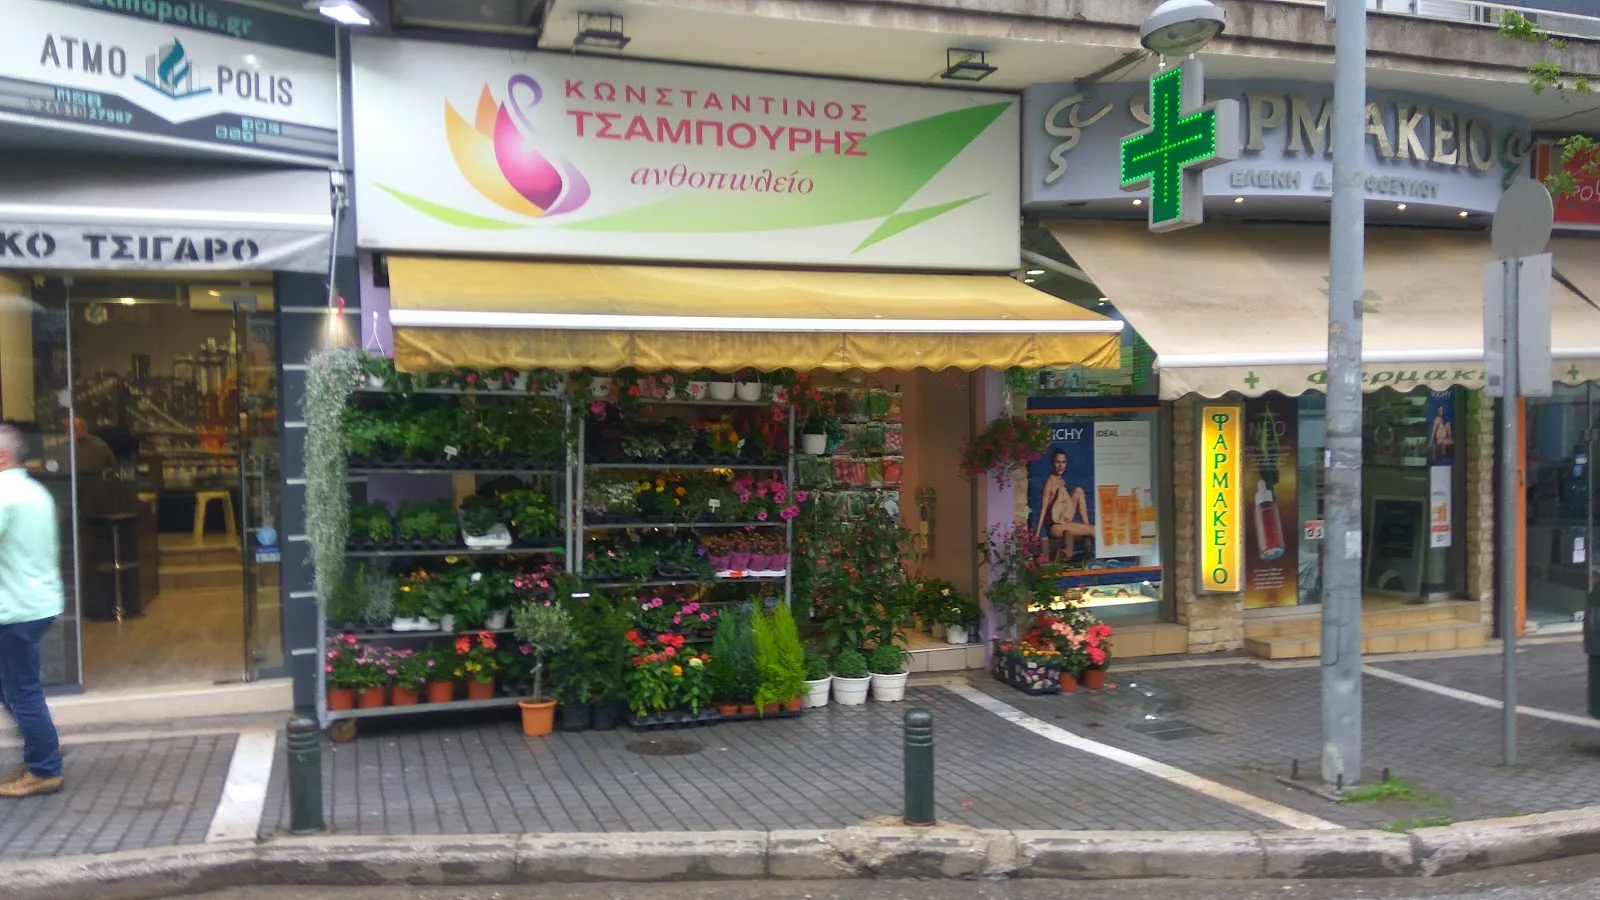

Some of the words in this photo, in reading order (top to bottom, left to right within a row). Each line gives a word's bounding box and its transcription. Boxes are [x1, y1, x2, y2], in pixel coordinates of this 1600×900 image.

[41, 34, 126, 77] ATMO
[217, 65, 293, 106] POLIS
[565, 79, 867, 122] ΚΩΝΣΤΑΝΤΙΝΟΣ
[566, 109, 867, 157] ΤΣΑΜΠΟΥΡΗΣ
[1130, 91, 1497, 172] ΡΜΑΚΕΙΟ
[630, 162, 814, 196] ανθοπωλείο
[1231, 168, 1301, 188] ΕΛΕΝΗ
[82, 234, 260, 261] ΤΣΙΓΑΡΟ
[1307, 368, 1486, 386] Φρμακ
[1212, 413, 1229, 584] ΦΑΡΜΑΚΕΙΟ
